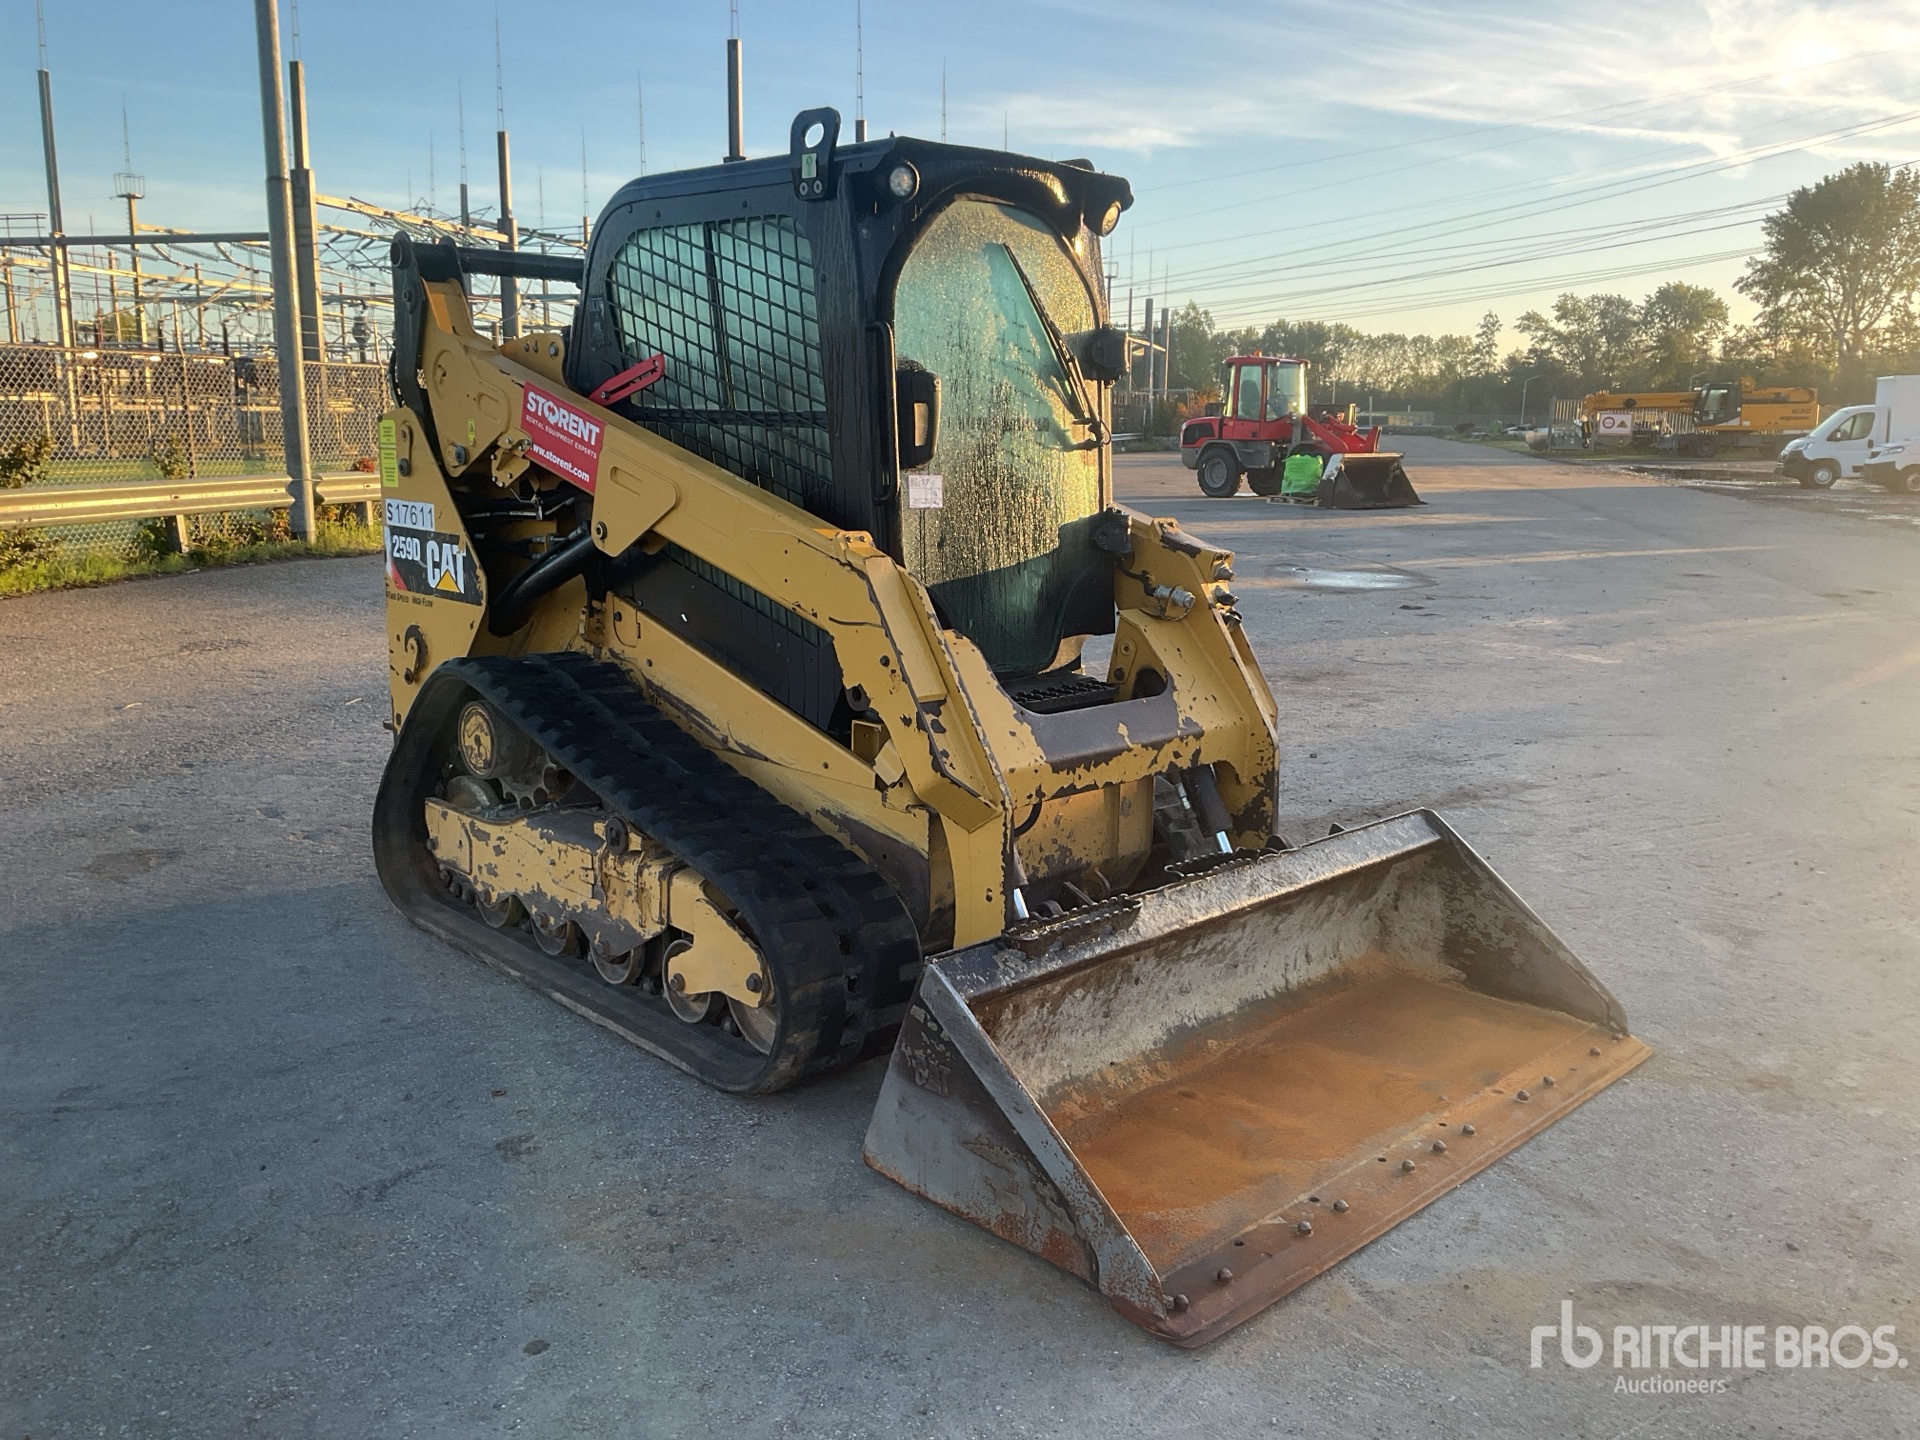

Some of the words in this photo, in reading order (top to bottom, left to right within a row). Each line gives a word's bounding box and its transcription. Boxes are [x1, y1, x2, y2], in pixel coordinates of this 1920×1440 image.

[526, 415, 544, 430] RENTAL
[545, 425, 574, 446] EQUIPMENT
[574, 441, 597, 459] EXPERTS
[527, 391, 600, 446] STORENT
[530, 443, 590, 482] ww.storent.com
[392, 535, 420, 561] 259D
[426, 540, 467, 594] CAT
